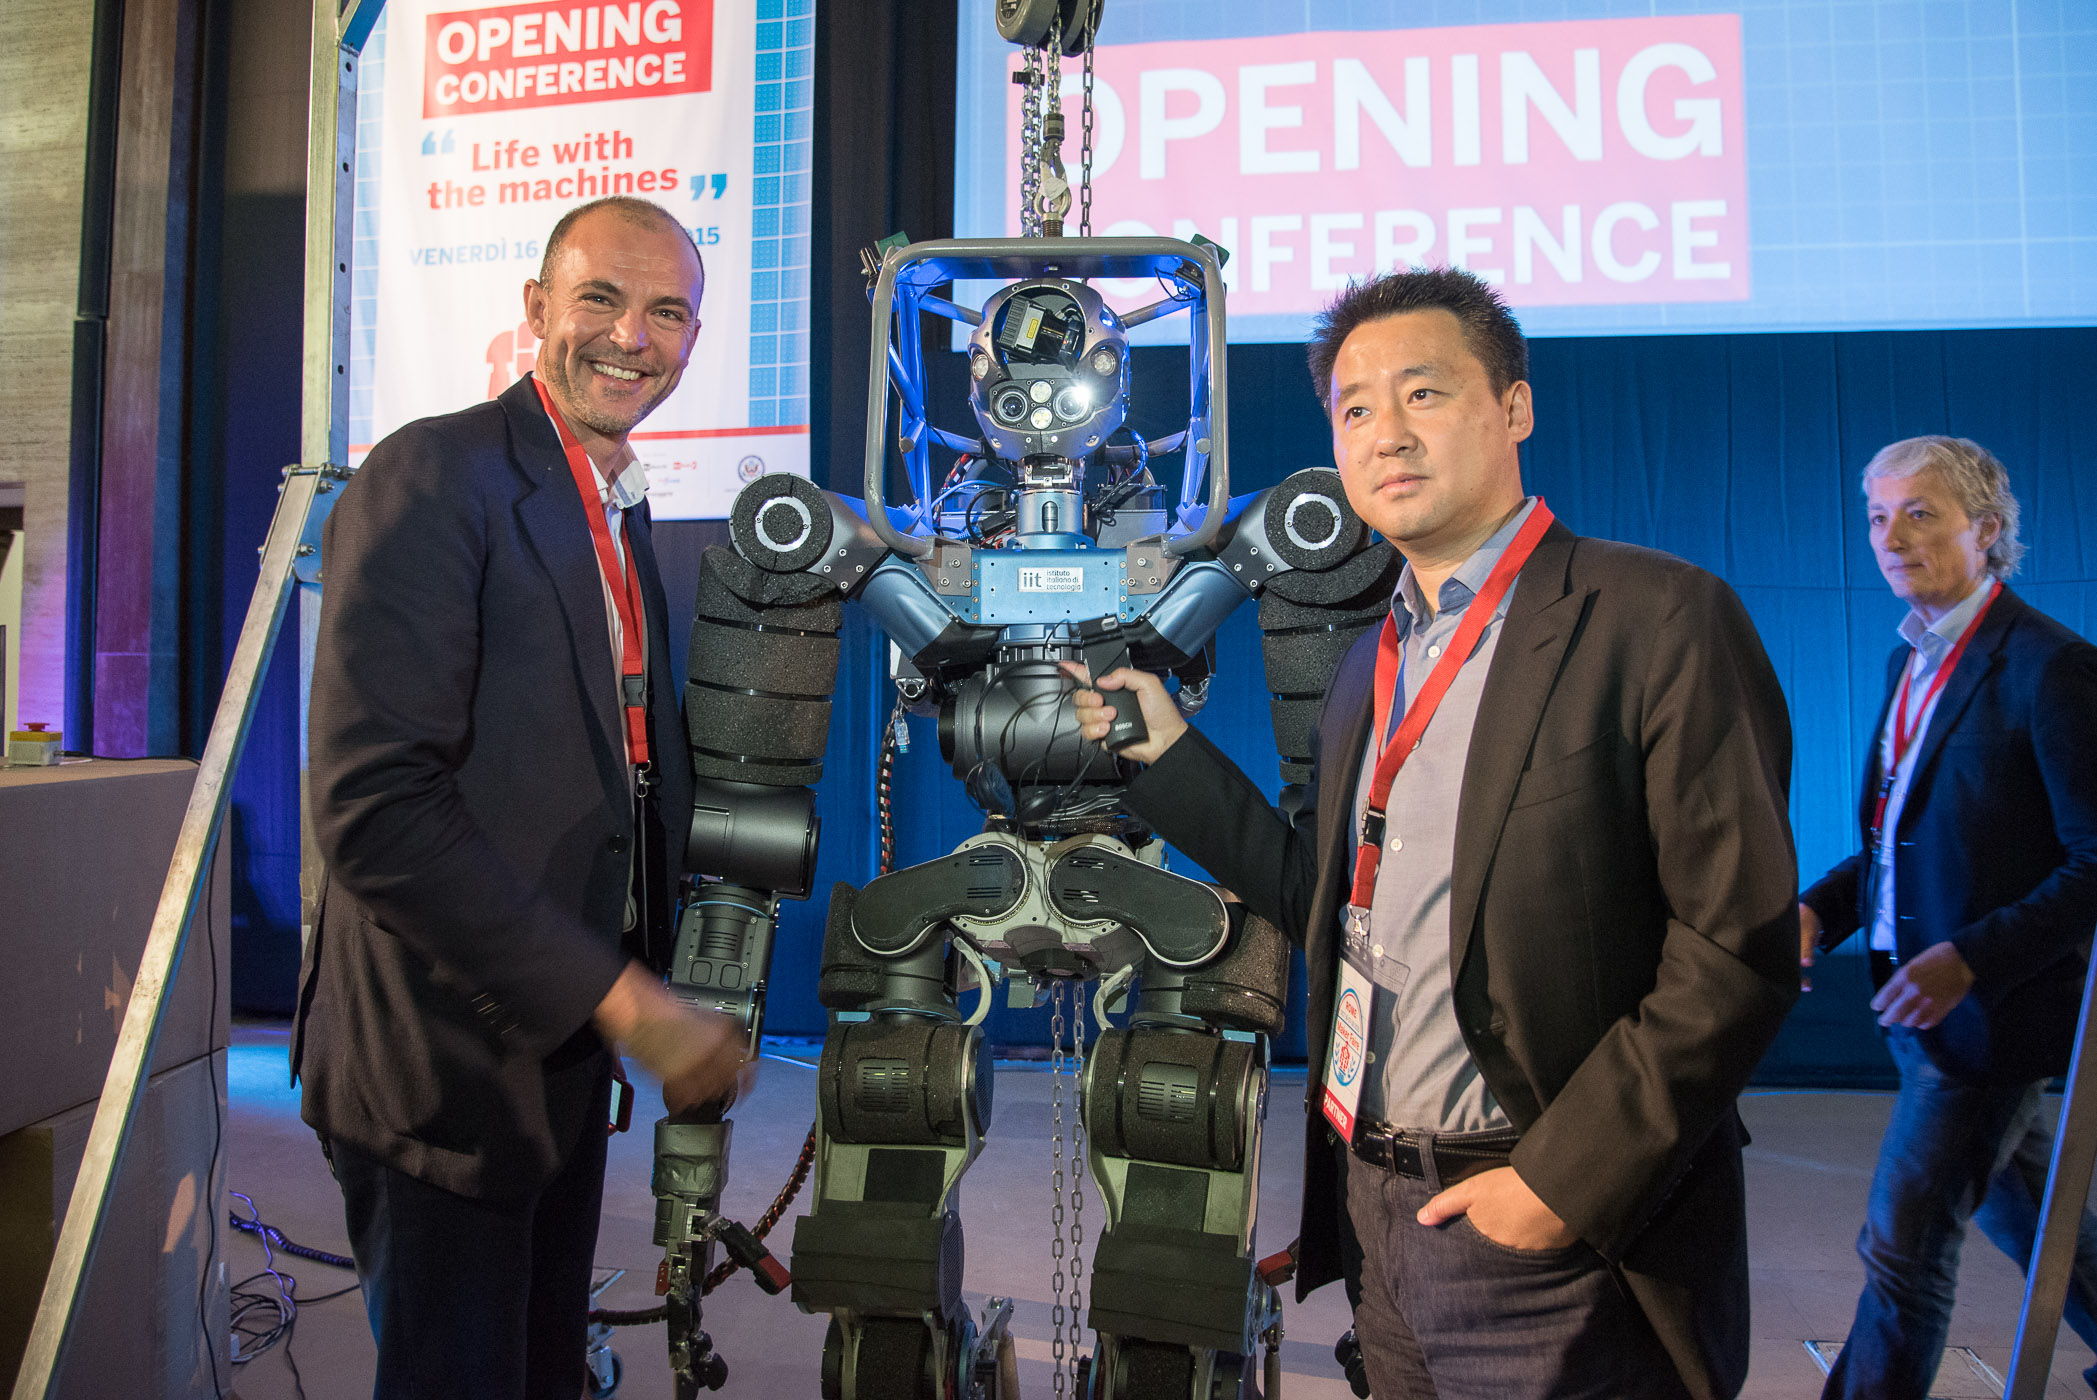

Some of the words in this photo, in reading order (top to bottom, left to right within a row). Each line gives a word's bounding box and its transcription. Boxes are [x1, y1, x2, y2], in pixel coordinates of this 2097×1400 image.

[436, 0, 683, 65] OPENING
[435, 51, 688, 105] CONFERENCE
[1034, 43, 1725, 185] OPENING
[471, 139, 541, 172] Life
[552, 130, 634, 164] with
[427, 180, 486, 210] the
[498, 166, 680, 204] machines
[409, 237, 507, 267] VENERDÌ
[513, 240, 539, 260] 16
[1028, 199, 1733, 300] ONFERENCE
[1023, 572, 1042, 588] iit
[1324, 1093, 1348, 1130] PARTNER
